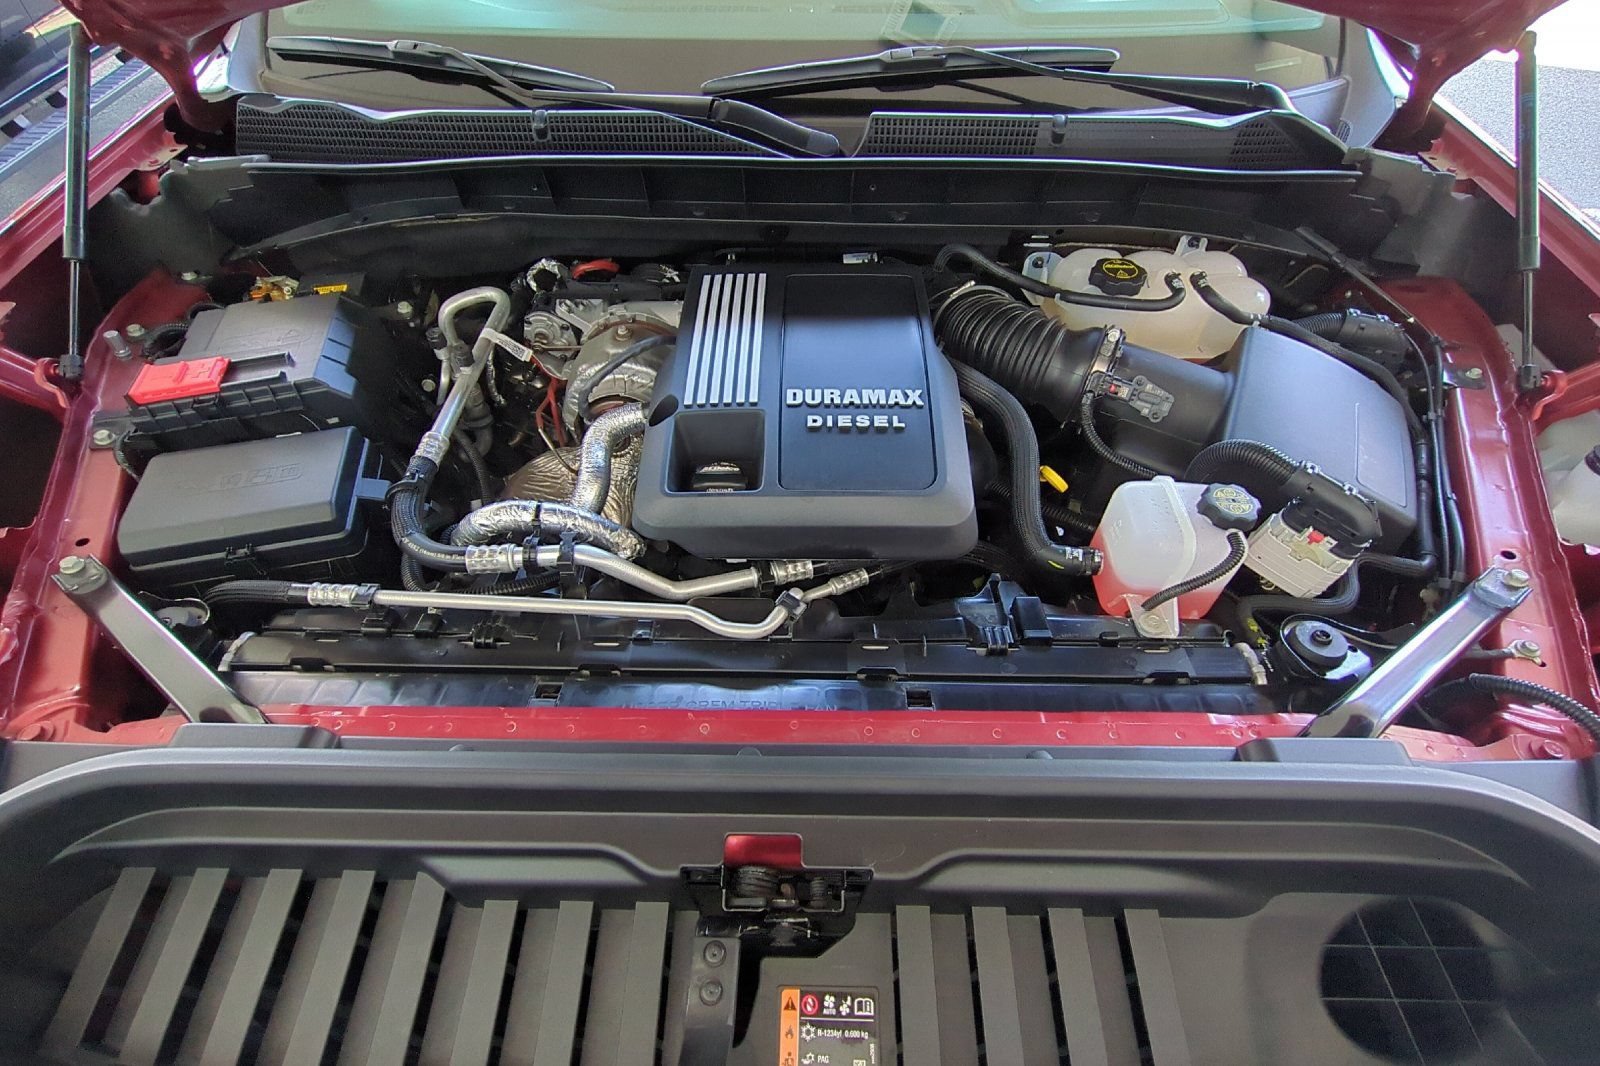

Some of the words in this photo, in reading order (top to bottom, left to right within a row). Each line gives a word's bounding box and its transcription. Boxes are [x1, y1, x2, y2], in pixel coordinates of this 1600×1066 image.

[786, 388, 924, 406] DURAMAX
[806, 415, 906, 428] DIESEL
[817, 1054, 830, 1065] PAG
